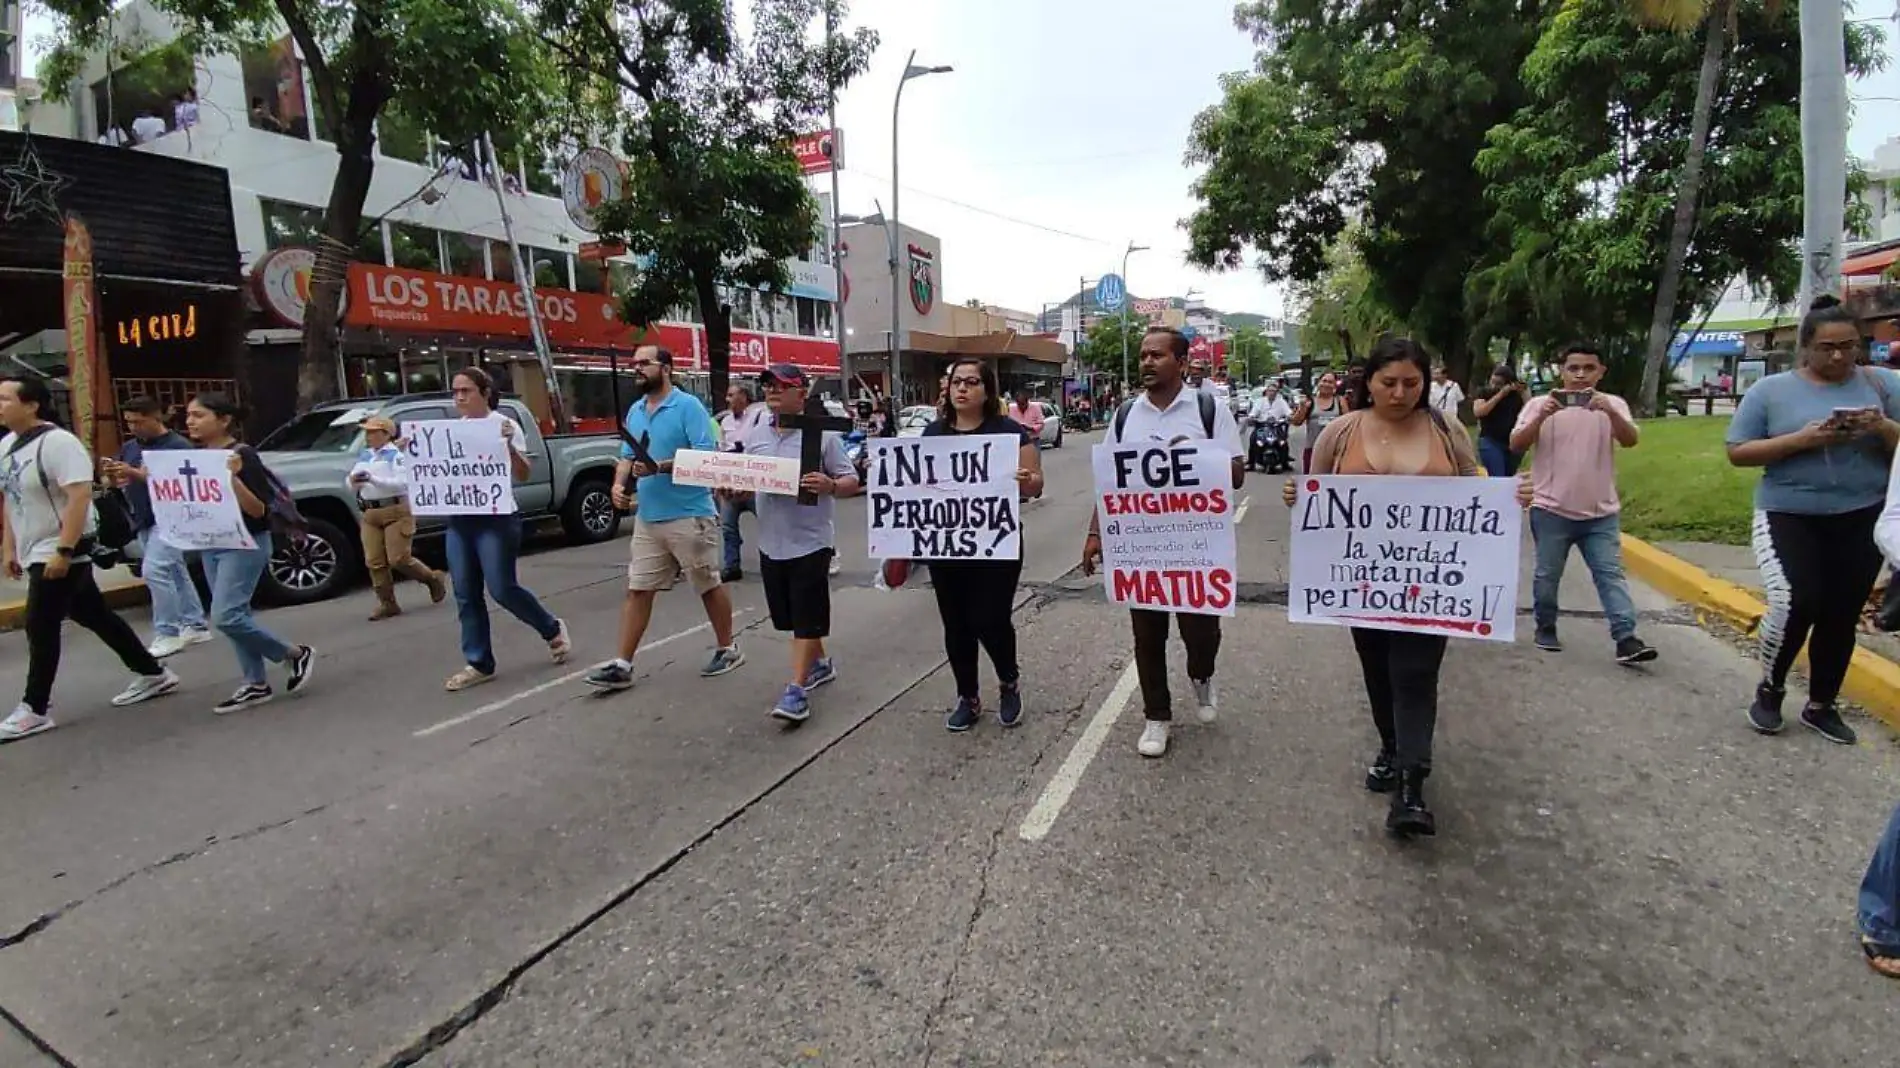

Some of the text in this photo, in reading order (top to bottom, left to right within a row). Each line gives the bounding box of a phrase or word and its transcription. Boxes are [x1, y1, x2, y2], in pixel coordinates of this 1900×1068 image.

[366, 272, 429, 308] LOS
[446, 428, 466, 459] la
[413, 454, 508, 482] prevención
[950, 442, 992, 484] UN
[1113, 447, 1200, 488] FGE
[152, 459, 223, 504] MATUS
[415, 483, 503, 514] del delito?
[871, 492, 1017, 532] PERIODISTA
[1103, 489, 1228, 515] EXIGIMOS
[1386, 502, 1411, 530] se
[1418, 495, 1505, 536] mata
[1107, 517, 1224, 535] el esclarecimiento
[1131, 540, 1185, 554] homicidio
[1191, 538, 1209, 552] del
[1343, 531, 1467, 568] la verdad,
[1113, 568, 1233, 609] MATUS
[1330, 559, 1465, 586] matando
